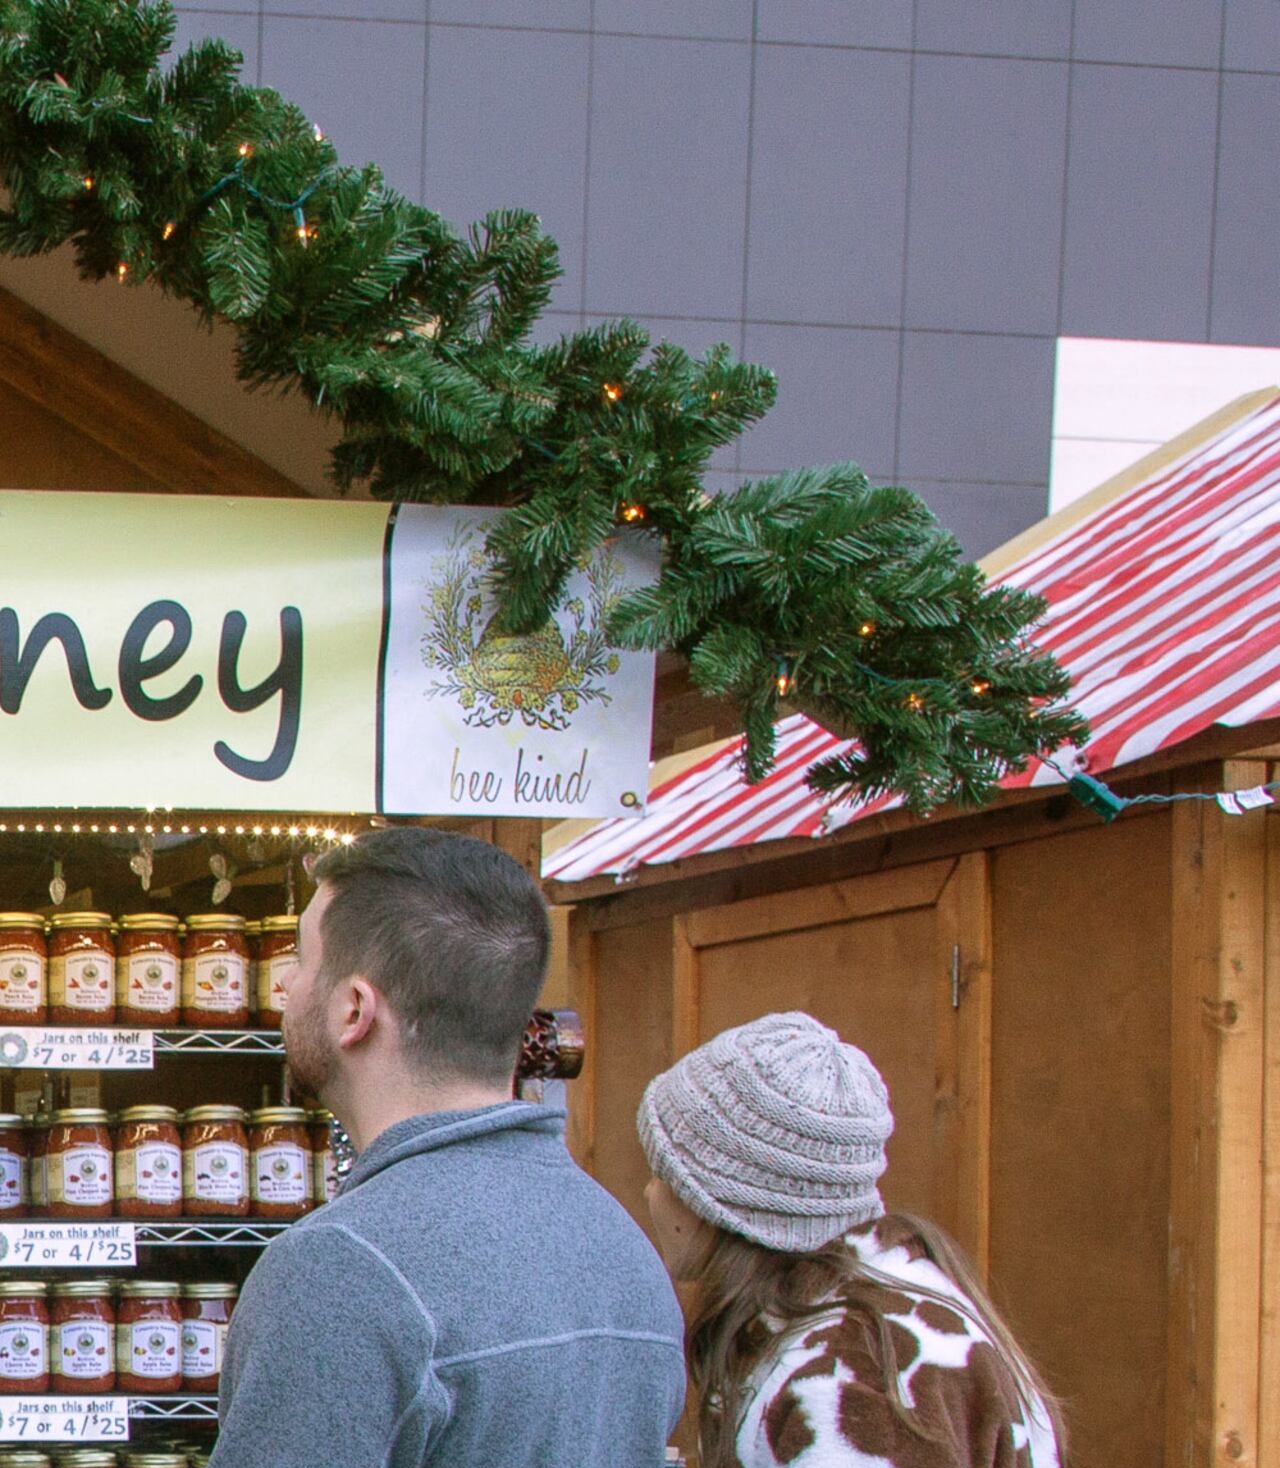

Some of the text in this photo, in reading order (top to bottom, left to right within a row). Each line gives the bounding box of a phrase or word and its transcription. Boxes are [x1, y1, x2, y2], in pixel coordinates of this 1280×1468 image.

[450, 747, 591, 804] bee kind
[43, 1031, 140, 1044] Jars on this shelf
[33, 1046, 54, 1065] $7
[61, 1052, 77, 1062] or
[22, 1225, 120, 1239] Jars on this shelf
[13, 1242, 35, 1262] $7
[42, 1247, 58, 1259] or
[17, 1399, 114, 1413] Jars on this shelf
[8, 1416, 28, 1436] $7
[36, 1421, 52, 1433] or
